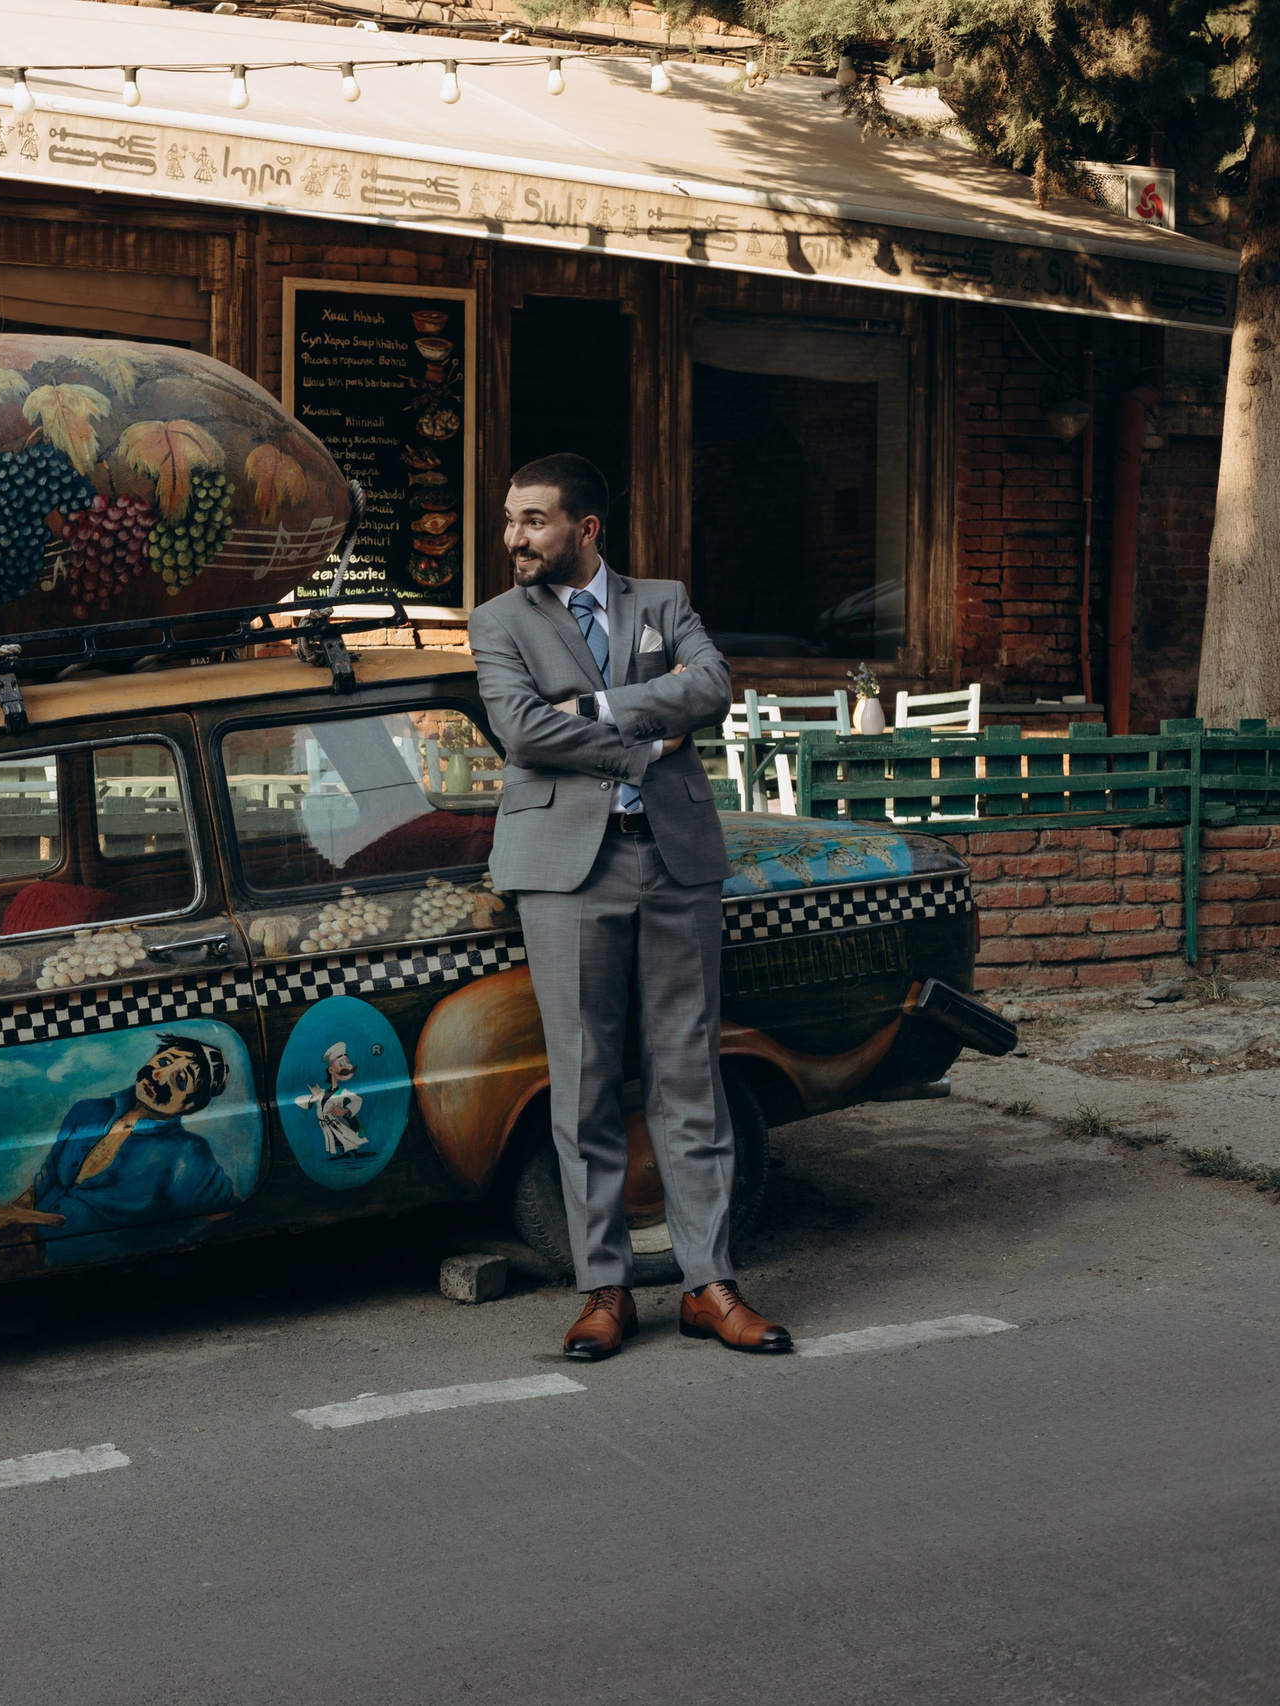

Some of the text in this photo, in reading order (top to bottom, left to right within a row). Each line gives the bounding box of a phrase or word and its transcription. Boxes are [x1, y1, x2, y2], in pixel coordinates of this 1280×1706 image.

[521, 187, 578, 237] Suli
[322, 309, 385, 324] Хаш Khash
[300, 332, 322, 348] Суп
[352, 336, 375, 350] Soup
[378, 355, 407, 368] Beans
[345, 378, 364, 390] pork
[343, 463, 380, 477] Форель
